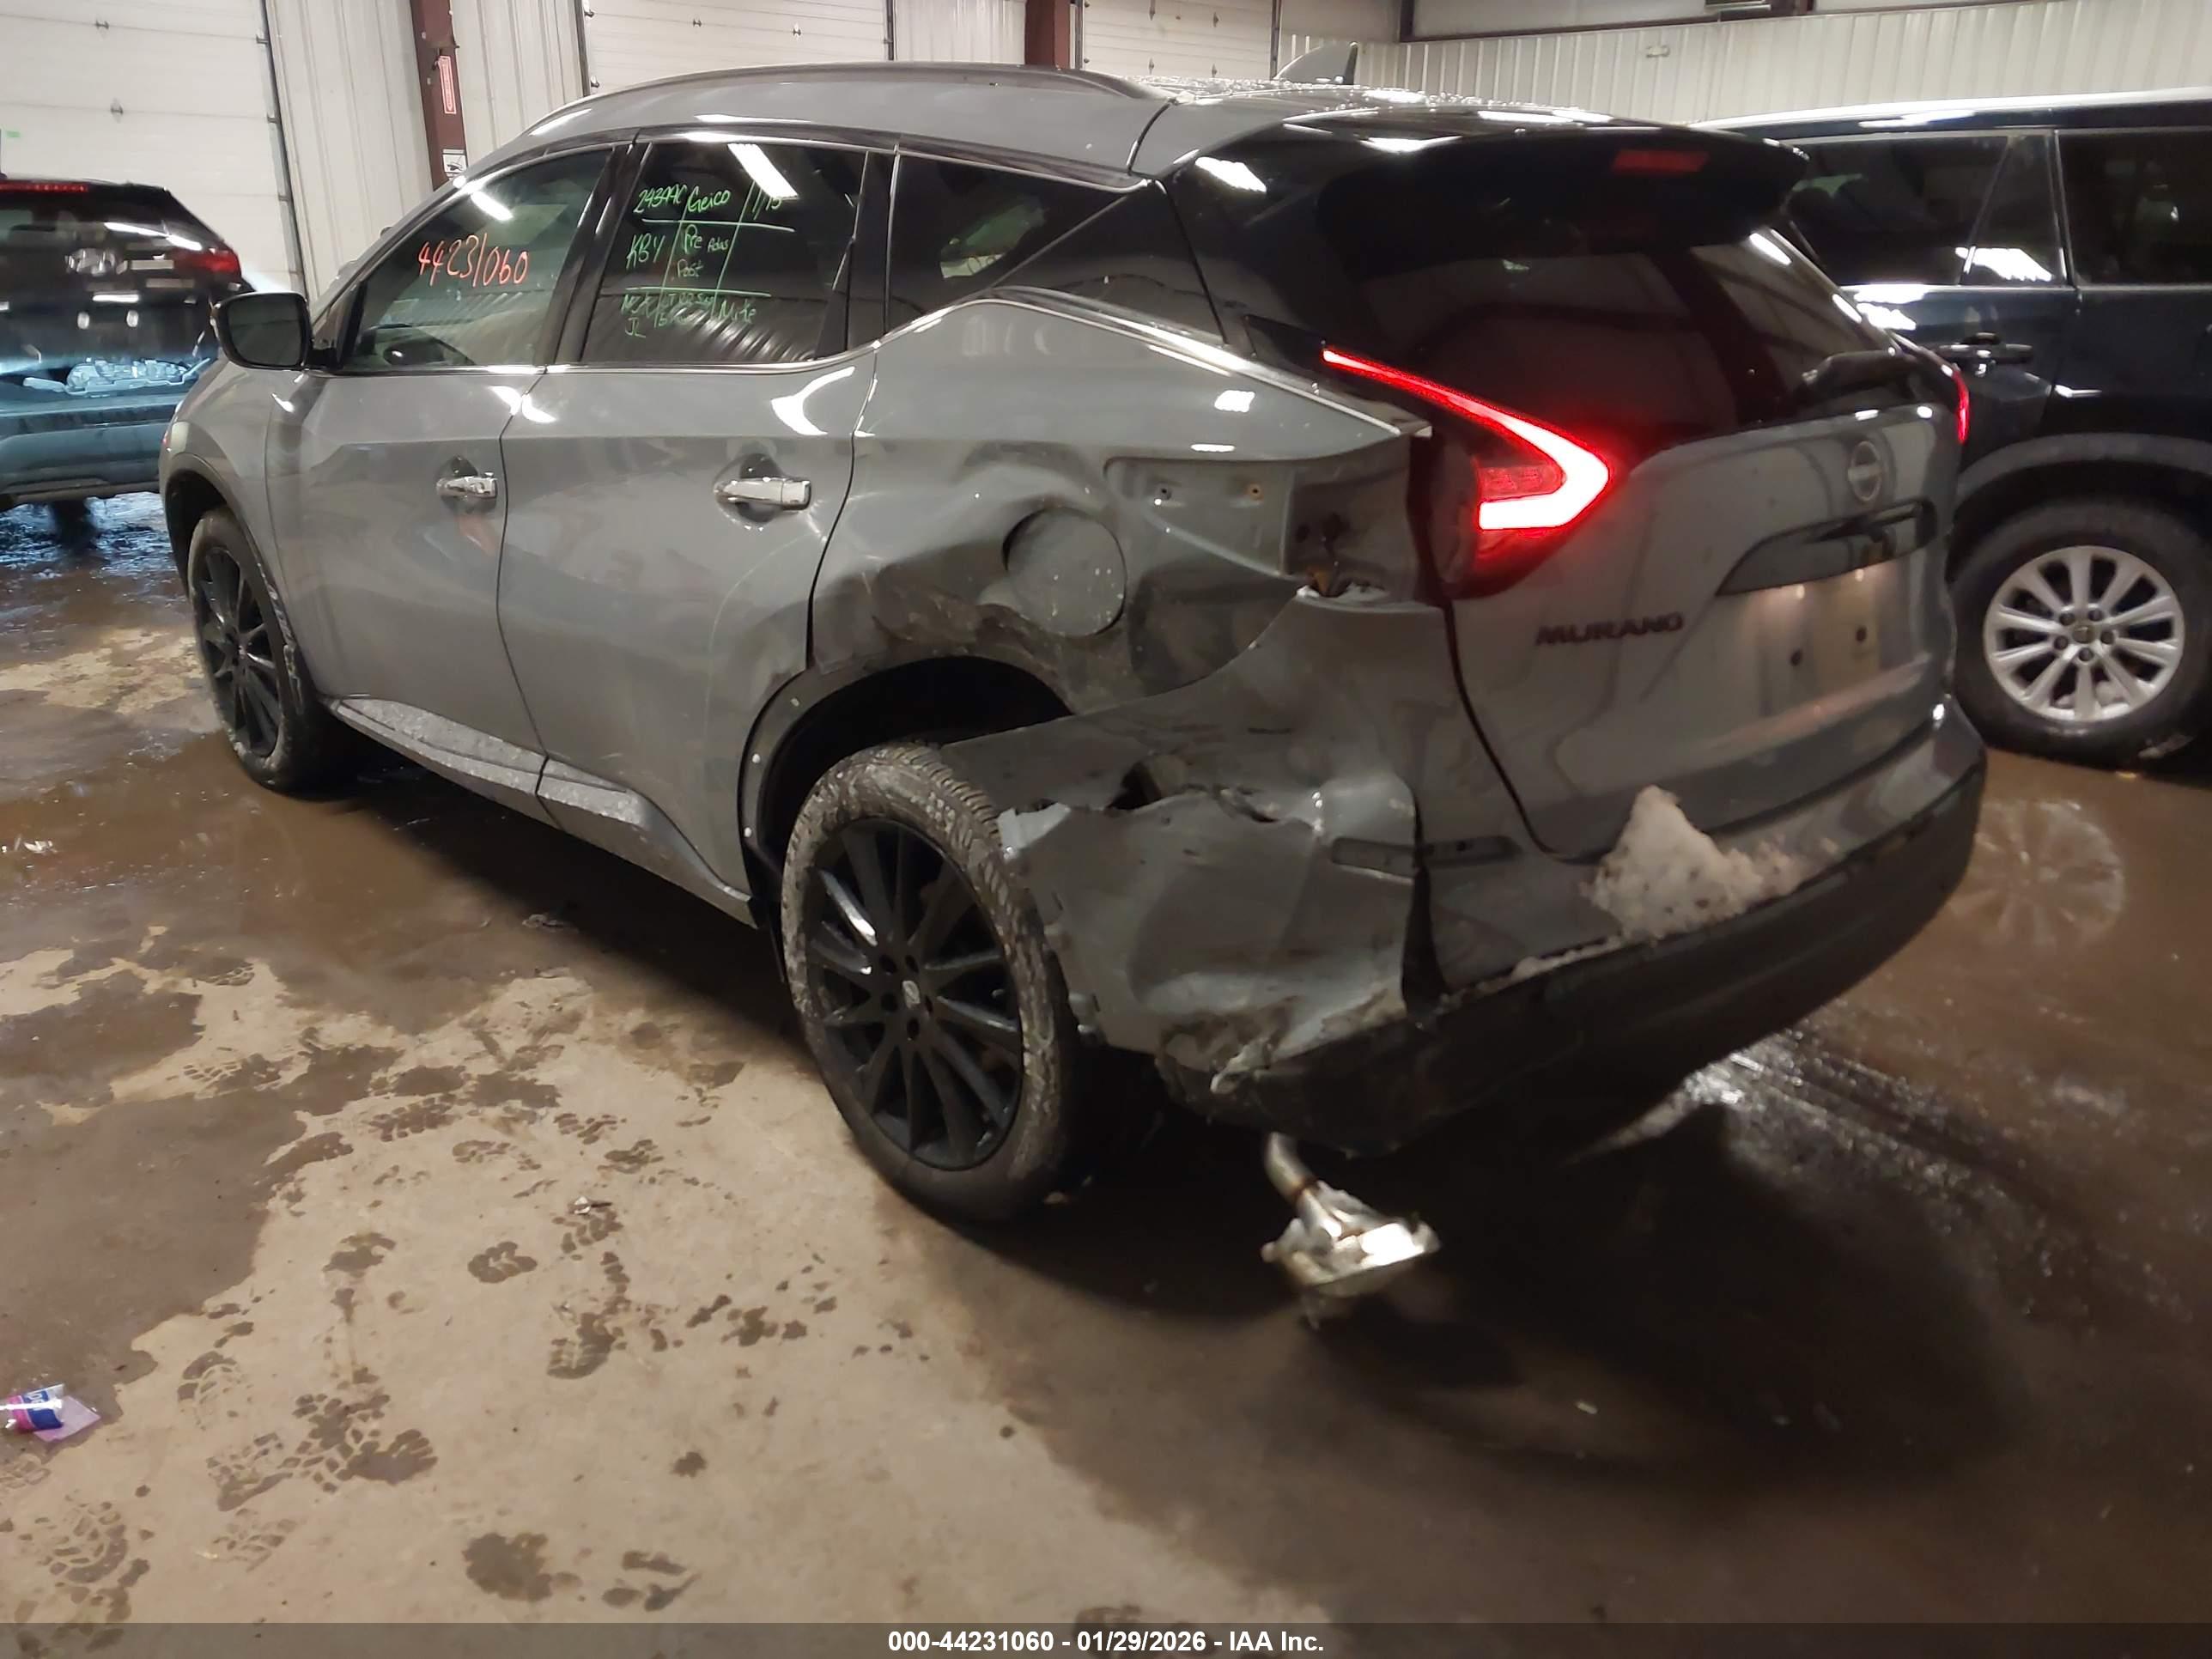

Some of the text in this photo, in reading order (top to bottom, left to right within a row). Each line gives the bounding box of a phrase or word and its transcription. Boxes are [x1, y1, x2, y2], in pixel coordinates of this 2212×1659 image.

[687, 185, 731, 213] Geico
[684, 223, 703, 254] Pre
[418, 232, 530, 288] 44231060
[677, 258, 704, 277] Post
[1534, 611, 1684, 646] MURANO
